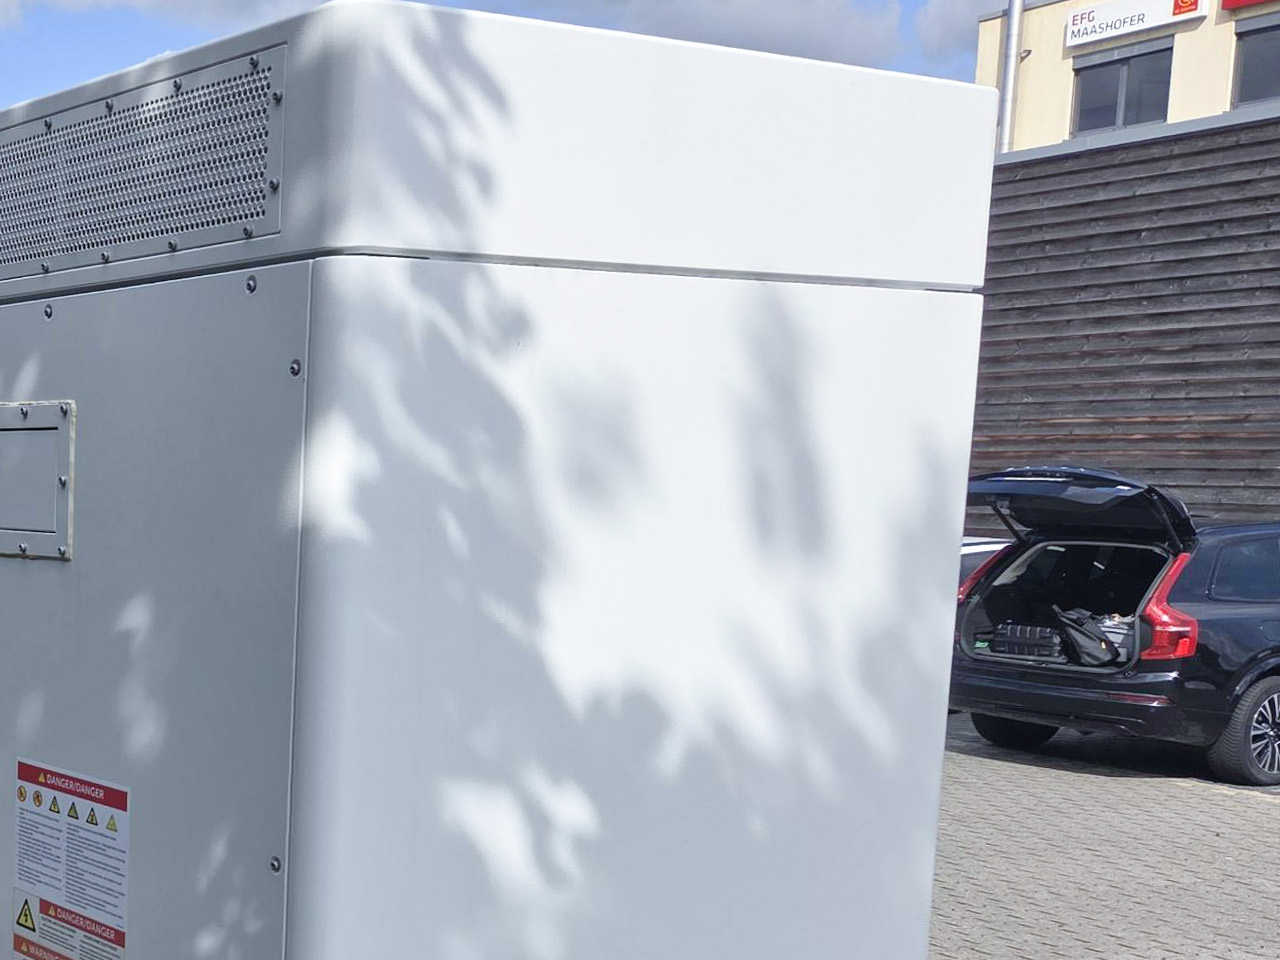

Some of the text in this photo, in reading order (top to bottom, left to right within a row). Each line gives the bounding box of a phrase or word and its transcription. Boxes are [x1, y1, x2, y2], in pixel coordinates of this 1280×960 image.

[1070, 13, 1146, 40] MAASHOFER
[1072, 10, 1095, 26] EFG
[46, 773, 105, 800] DANGER/DANGER
[56, 908, 115, 940] DANGER/DANGER
